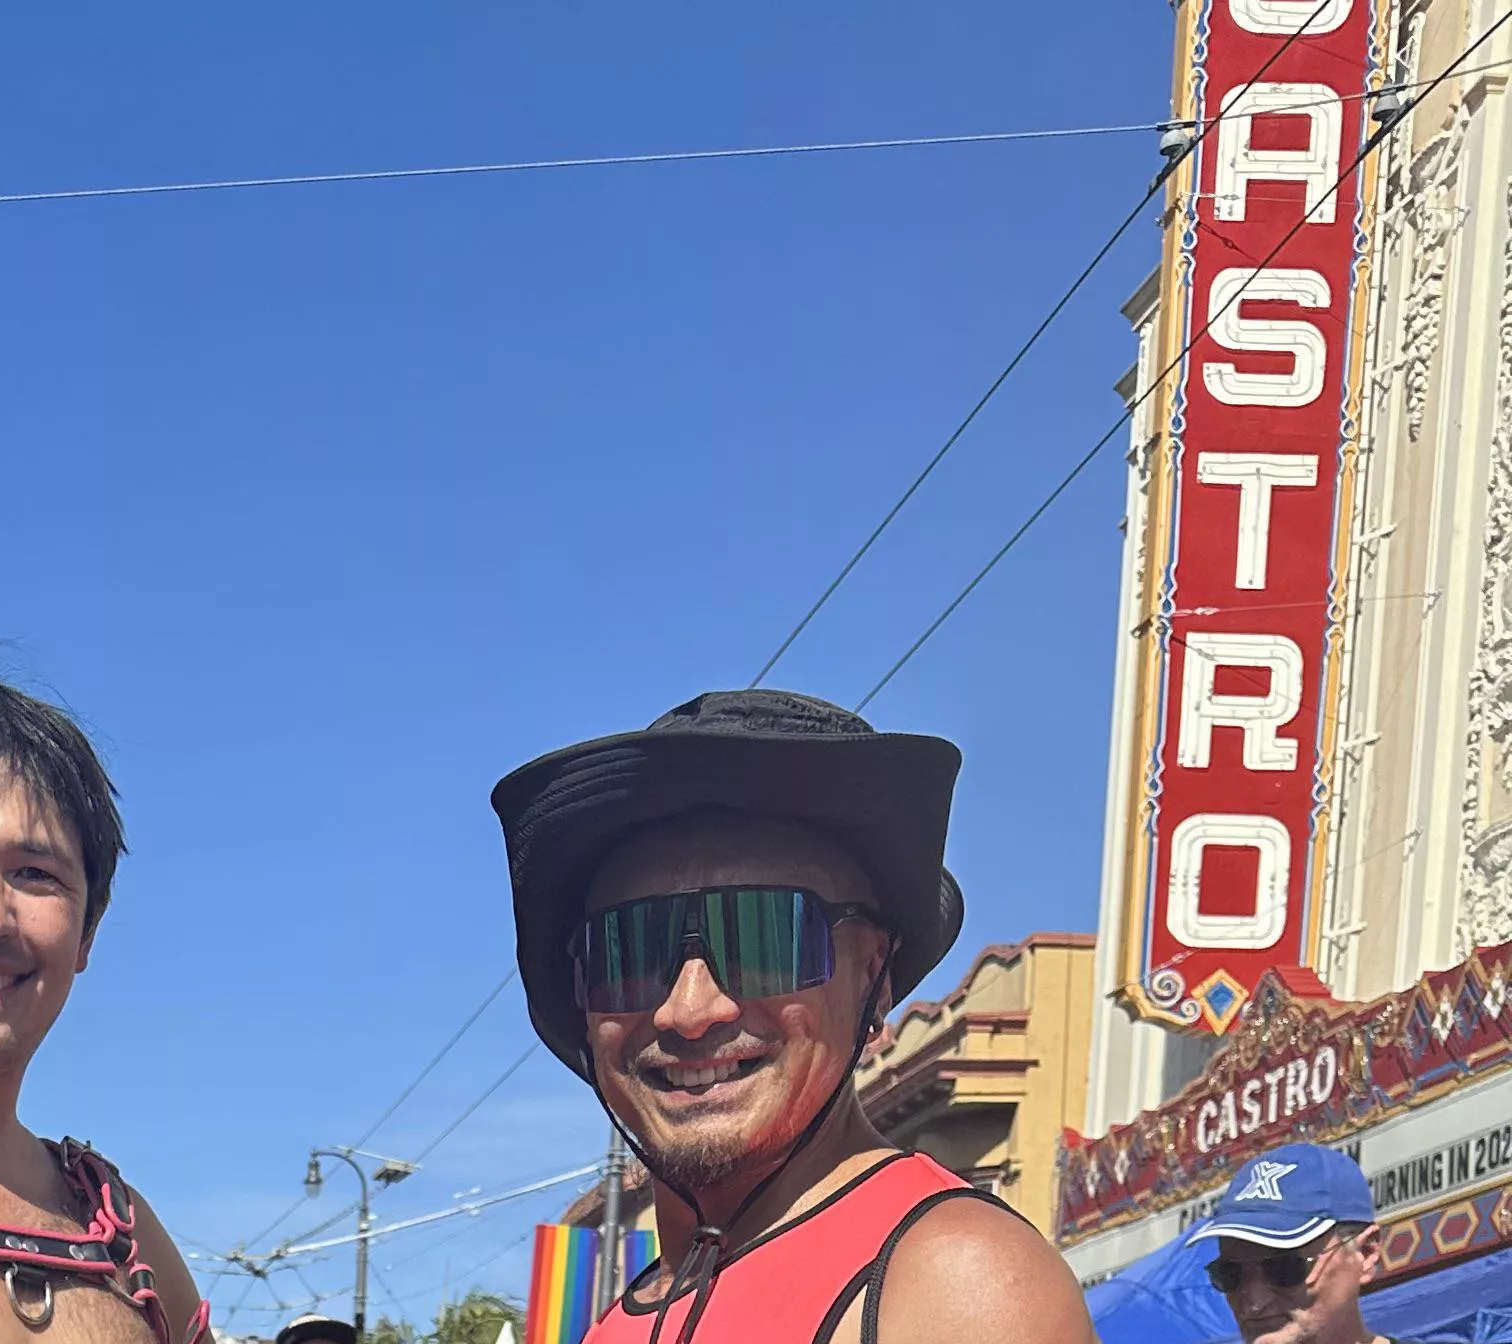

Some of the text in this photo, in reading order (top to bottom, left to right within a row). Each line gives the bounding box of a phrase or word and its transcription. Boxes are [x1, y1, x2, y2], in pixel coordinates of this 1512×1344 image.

[1167, 0, 1354, 949] ASTRO
[1197, 1046, 1336, 1153] CASTRO
[1368, 1152, 1443, 1210] URNING
[1448, 1140, 1470, 1186] IN
